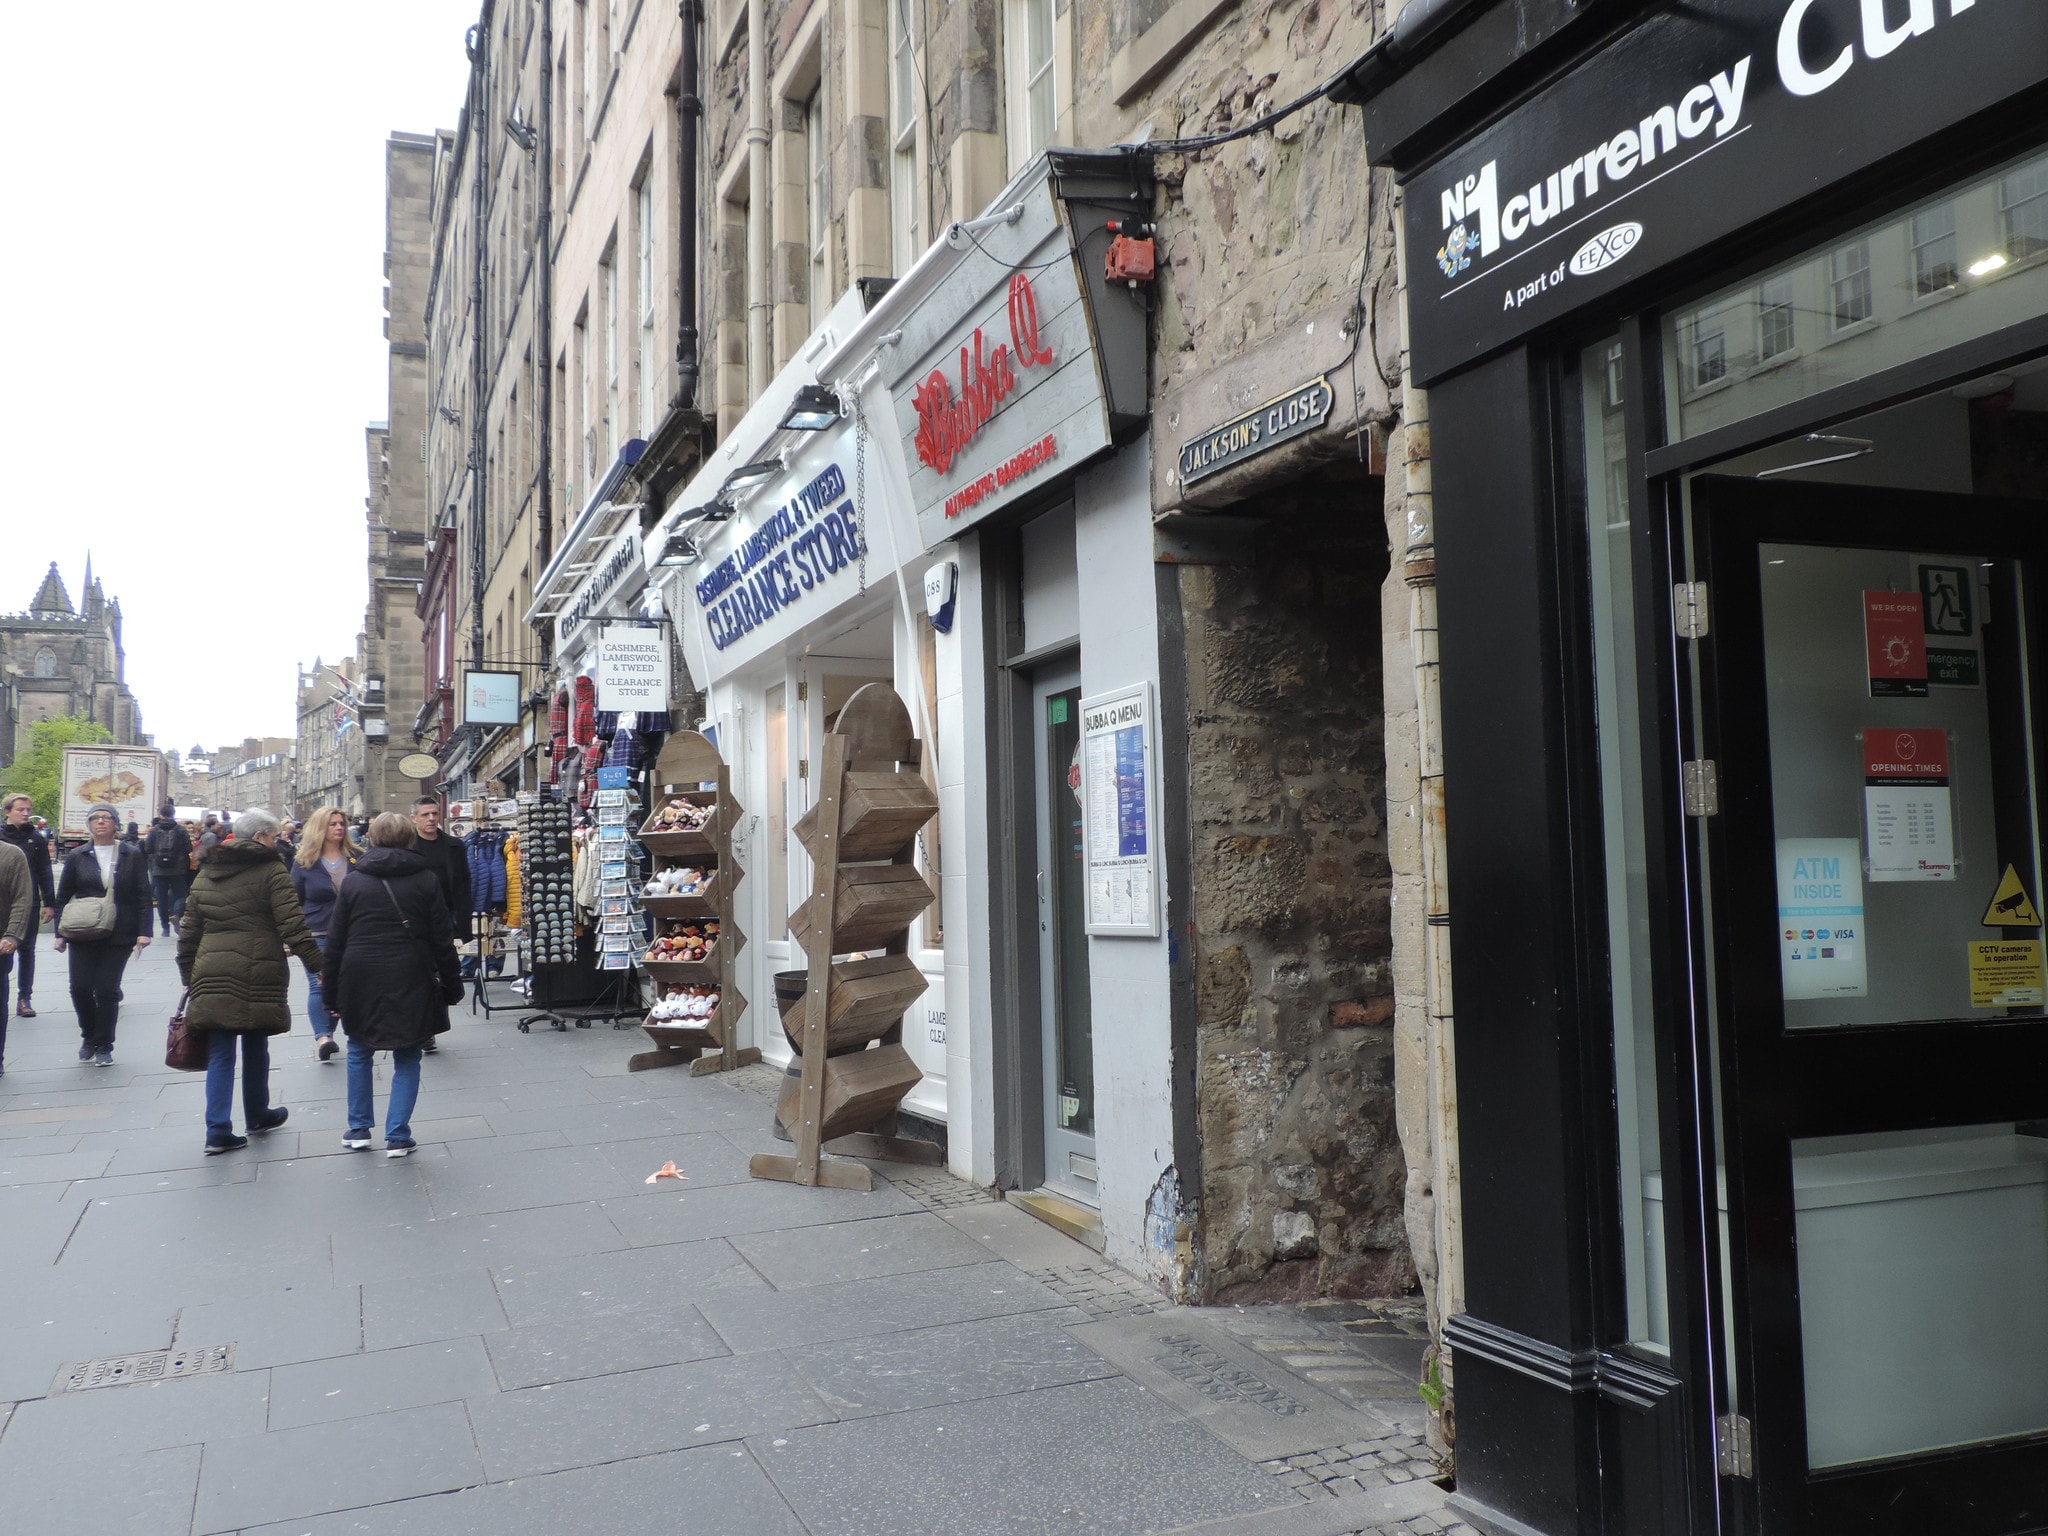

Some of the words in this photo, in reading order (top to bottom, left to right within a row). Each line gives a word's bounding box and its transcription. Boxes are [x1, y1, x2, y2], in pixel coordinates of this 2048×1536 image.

[1777, 0, 1975, 96] Cu
[1501, 55, 1751, 241] currency
[1503, 290, 1514, 311] A
[1517, 272, 1547, 308] part
[1549, 261, 1565, 287] of
[1579, 229, 1636, 268] FEXCO
[1008, 273, 1053, 368] Q
[1185, 417, 1261, 473] JACKSON'S
[1268, 388, 1321, 435] CLOSE
[944, 472, 996, 519] AUTHENTIC
[996, 432, 1056, 487] BARBECUE
[735, 505, 798, 573] LAMBSWOOL
[790, 498, 806, 529] &
[798, 463, 846, 520] TWEED
[706, 550, 800, 651] CLEARANCE
[794, 498, 868, 590] STORE
[1896, 605, 1918, 613] OPEN
[604, 644, 660, 654] CASHMERE,
[602, 653, 663, 663] LAMBSWOOL
[1927, 654, 1976, 668] mergency
[612, 663, 619, 672] &
[620, 663, 656, 673] TWEED
[1939, 668, 1959, 678] exit
[605, 678, 663, 687] CLEARANCE
[618, 688, 650, 697] STORE
[1086, 711, 1109, 732] BUBBA
[1109, 709, 1117, 725] Q
[1118, 702, 1142, 723] MENU
[1871, 763, 1913, 772] OPENING
[1914, 764, 1943, 772] TIMES
[1792, 857, 1840, 880] ATM
[1794, 884, 1842, 899] INSIDE
[1834, 929, 1855, 940] VISA
[1979, 946, 1999, 954] CCTV
[1993, 954, 2028, 963] operation
[1152, 1354, 1243, 1405] CLOSE
[1158, 1334, 1311, 1418] JACKSON'S
